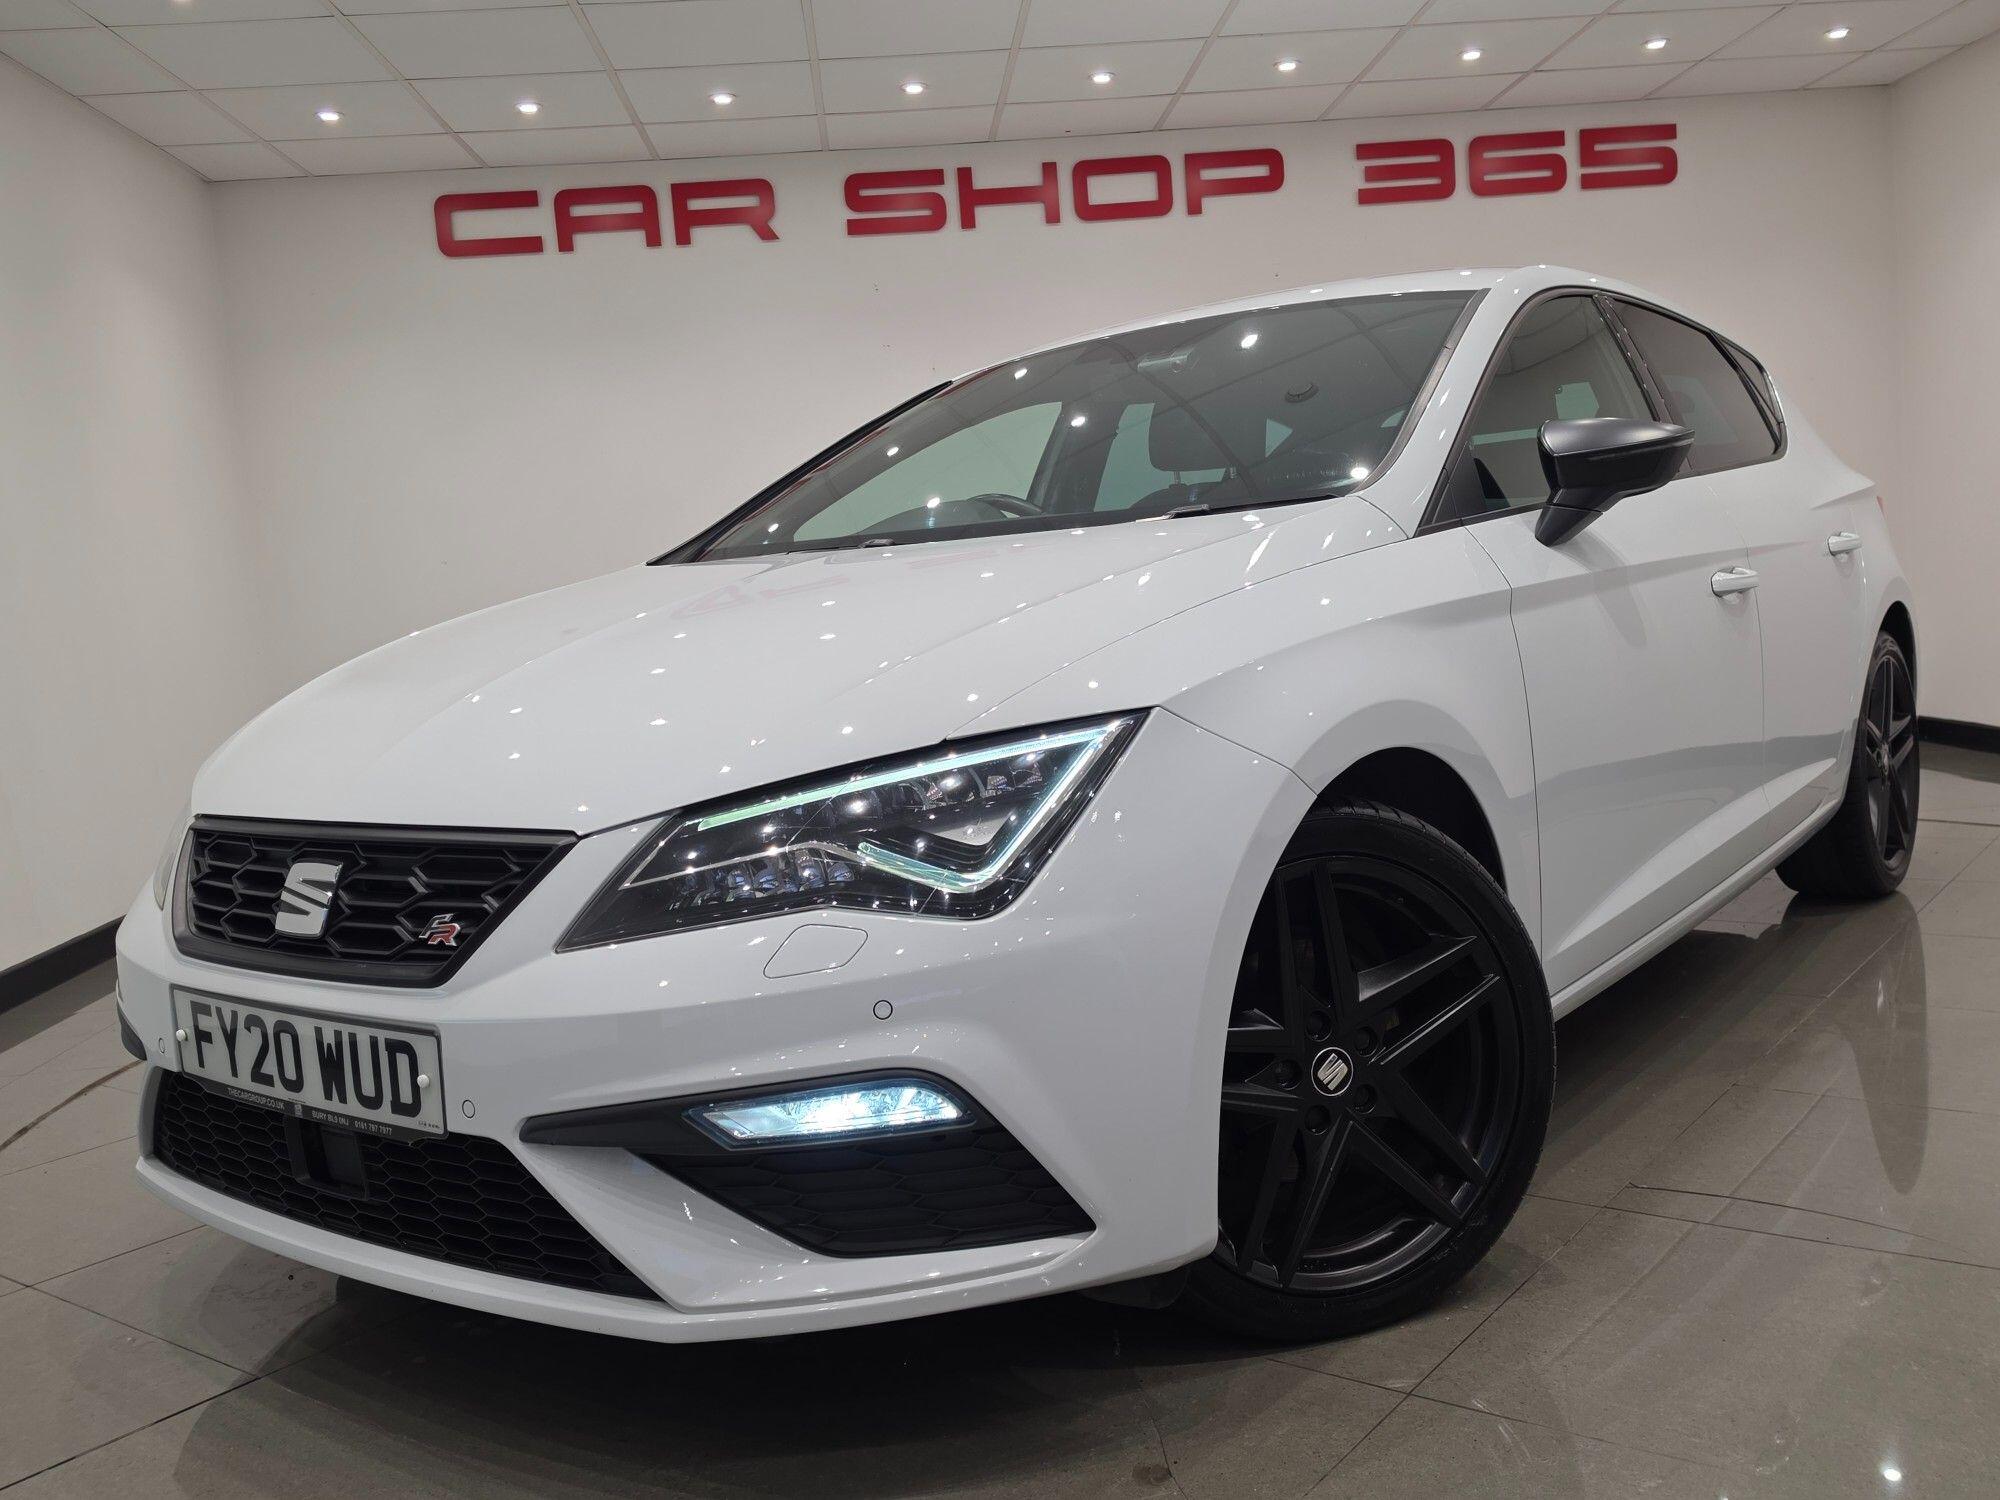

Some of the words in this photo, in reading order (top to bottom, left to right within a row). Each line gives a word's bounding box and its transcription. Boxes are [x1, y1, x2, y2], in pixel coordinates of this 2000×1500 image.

[434, 178, 779, 257] CAR
[844, 148, 1285, 236] SHOP
[1356, 123, 1678, 205] 365
[190, 1000, 304, 1093] FY20
[314, 1025, 422, 1118] WUD
